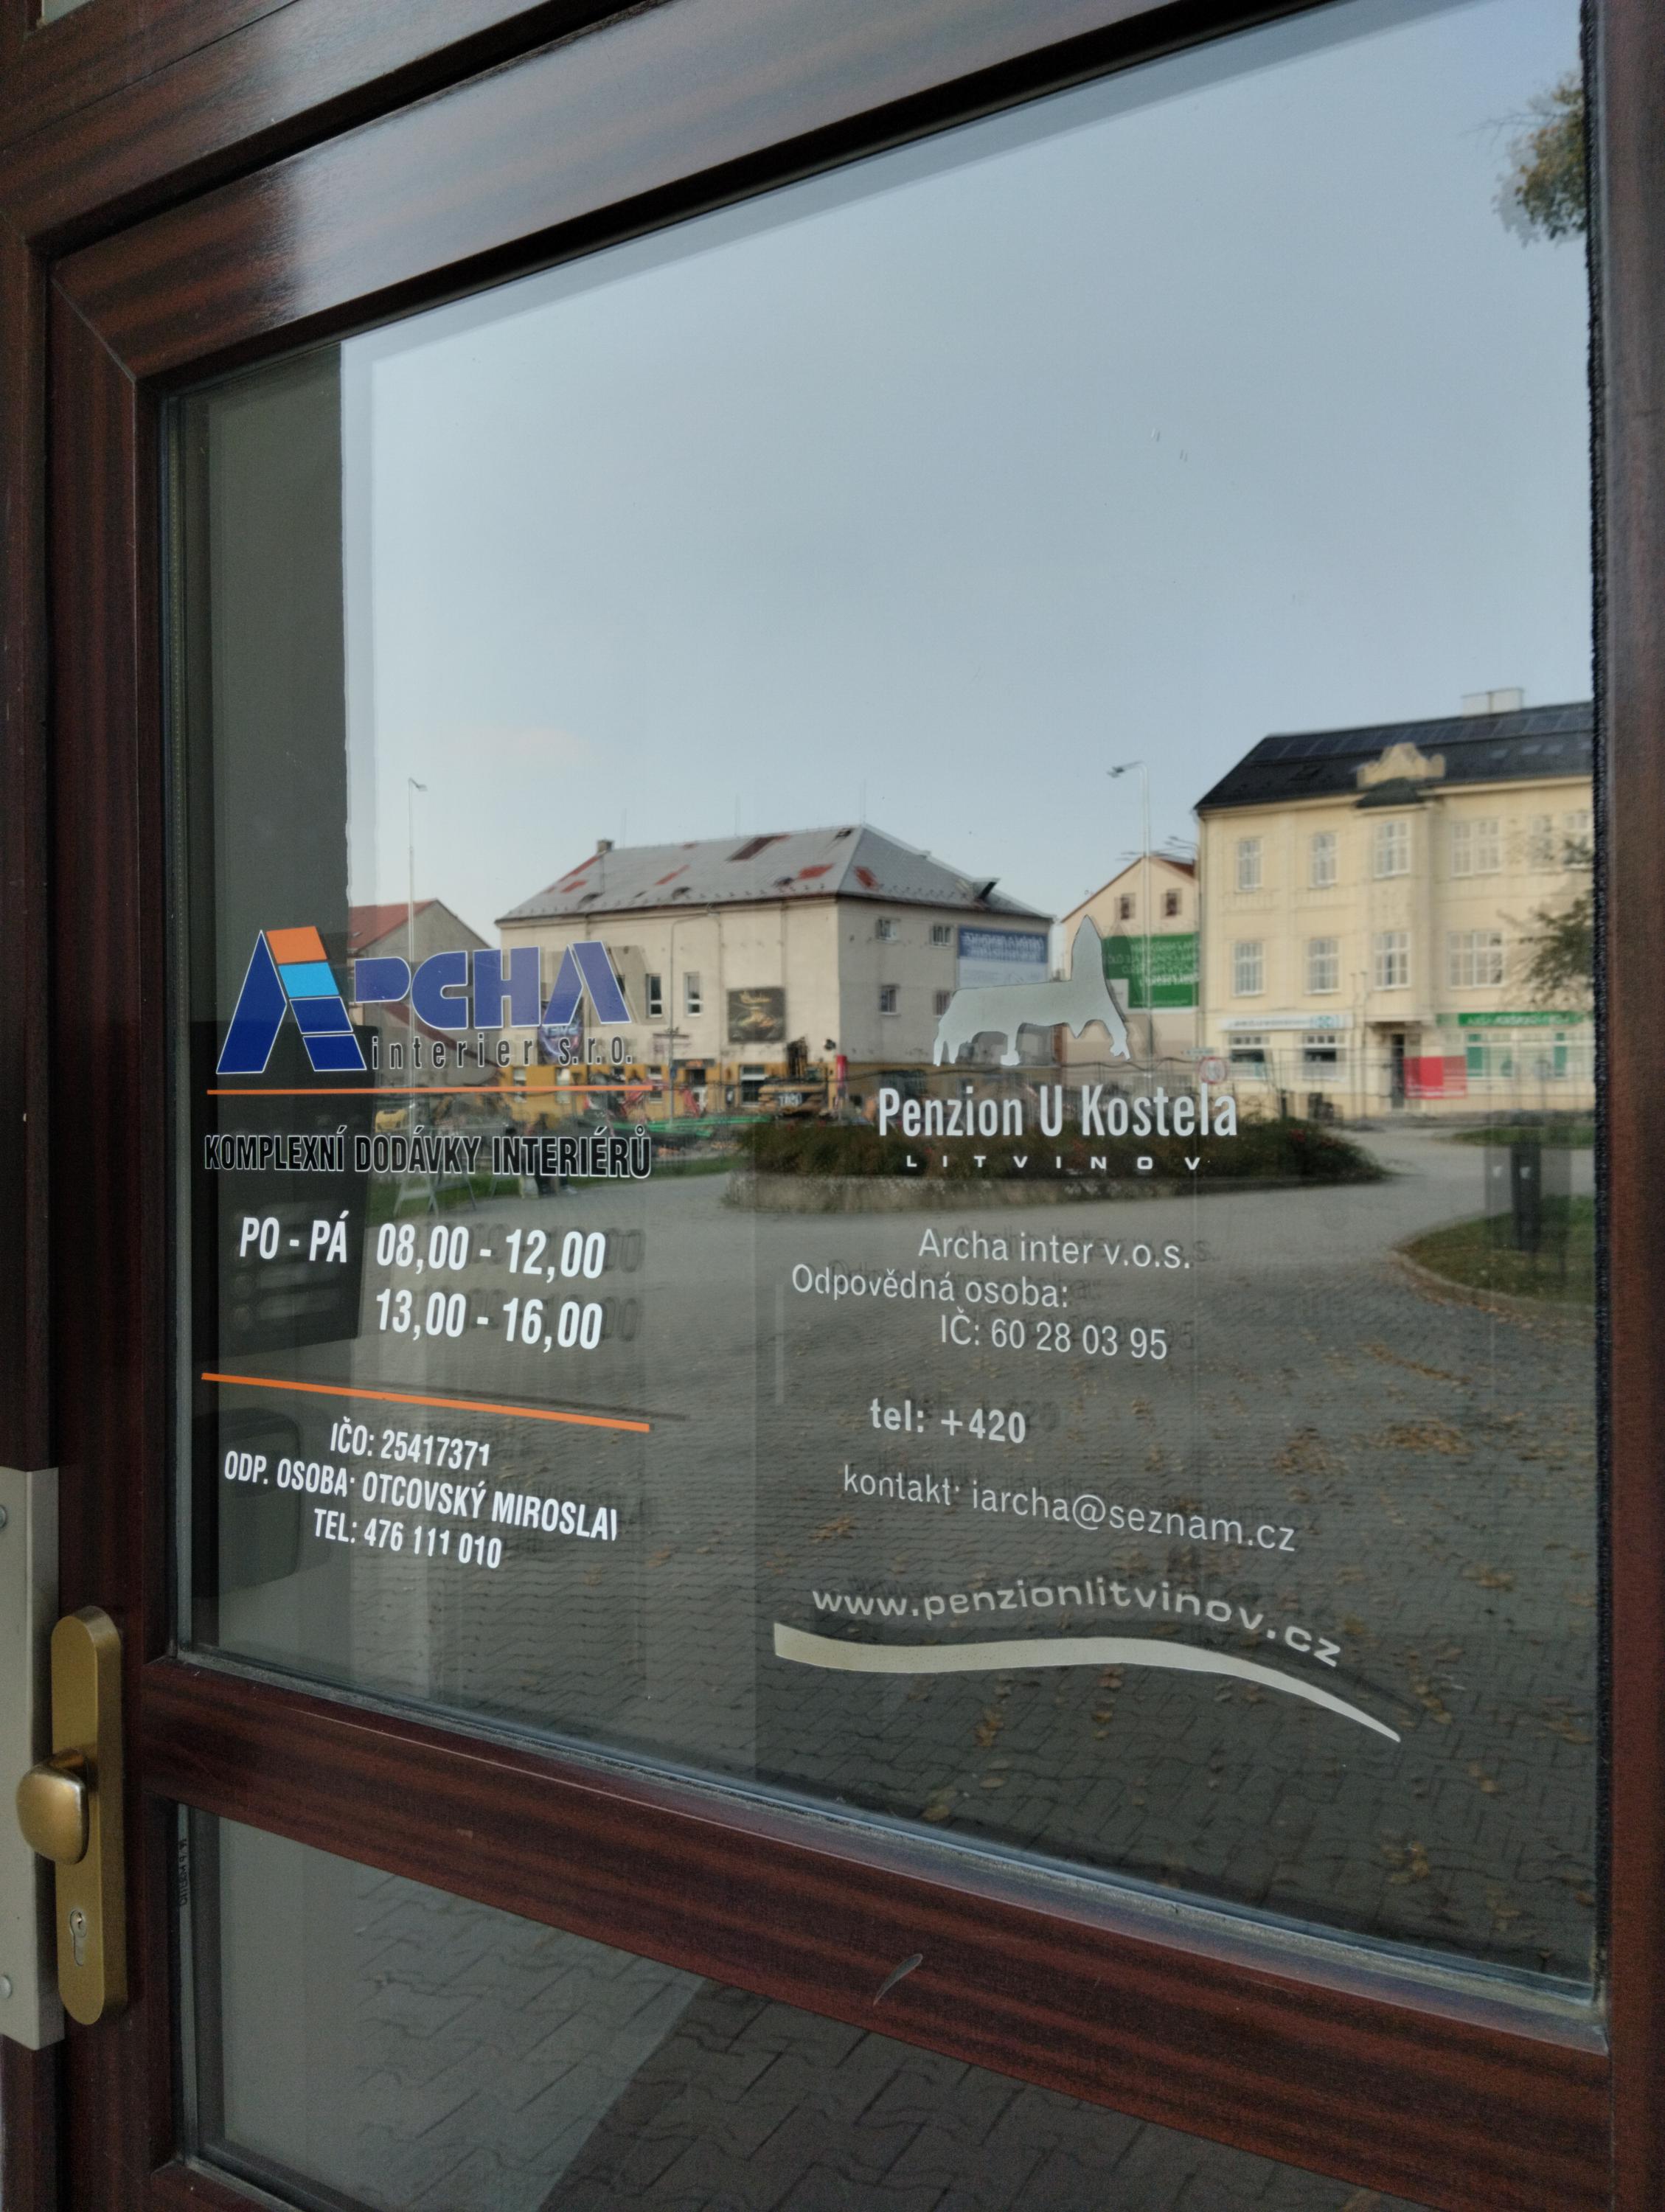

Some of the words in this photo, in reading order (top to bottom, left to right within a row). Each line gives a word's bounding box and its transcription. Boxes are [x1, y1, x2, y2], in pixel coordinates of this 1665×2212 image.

[372, 1033, 533, 1071] interier
[558, 1034, 633, 1067] s.r.o.
[878, 1086, 1023, 1137] Penzion
[1040, 1085, 1063, 1137] U
[1082, 1084, 1237, 1137] Kostela
[204, 1125, 347, 1172] KOMPLEXNÍ
[355, 1125, 482, 1175] DODÁVKY
[493, 1124, 652, 1178] INTERIÉRŮ
[906, 1155, 1200, 1171] LITVINOV
[239, 1217, 279, 1259] PO
[309, 1210, 350, 1263] PÁ
[376, 1222, 469, 1275] 08,00
[506, 1228, 606, 1283] 12,00
[918, 1228, 1009, 1262] Archa
[1020, 1232, 1094, 1265] inter
[1104, 1244, 1191, 1270] v.o.s.
[792, 1264, 954, 1302] Odpovědná
[964, 1276, 1068, 1308] osoba:
[376, 1288, 467, 1340] 13,00
[503, 1297, 603, 1352] 16,00
[941, 1306, 980, 1346] IČ:
[991, 1318, 1026, 1349] 60
[1037, 1322, 1071, 1354] 28
[1082, 1325, 1119, 1357] 03
[1130, 1328, 1167, 1360] 95
[330, 1416, 375, 1456] IČO:
[380, 1429, 490, 1471] 25417371
[869, 1398, 925, 1434] tel:
[941, 1408, 1026, 1444] +420
[224, 1450, 268, 1485] ODP.
[362, 1471, 487, 1519] OTCOVSKÝ
[314, 1508, 358, 1544] TEL:
[364, 1518, 403, 1551] 476
[414, 1526, 450, 1557] 111
[458, 1532, 502, 1568] 010
[973, 1479, 1295, 1552] iarcha@seznam.cz
[813, 1576, 1341, 1667] www.penzionlitvinov.cz
